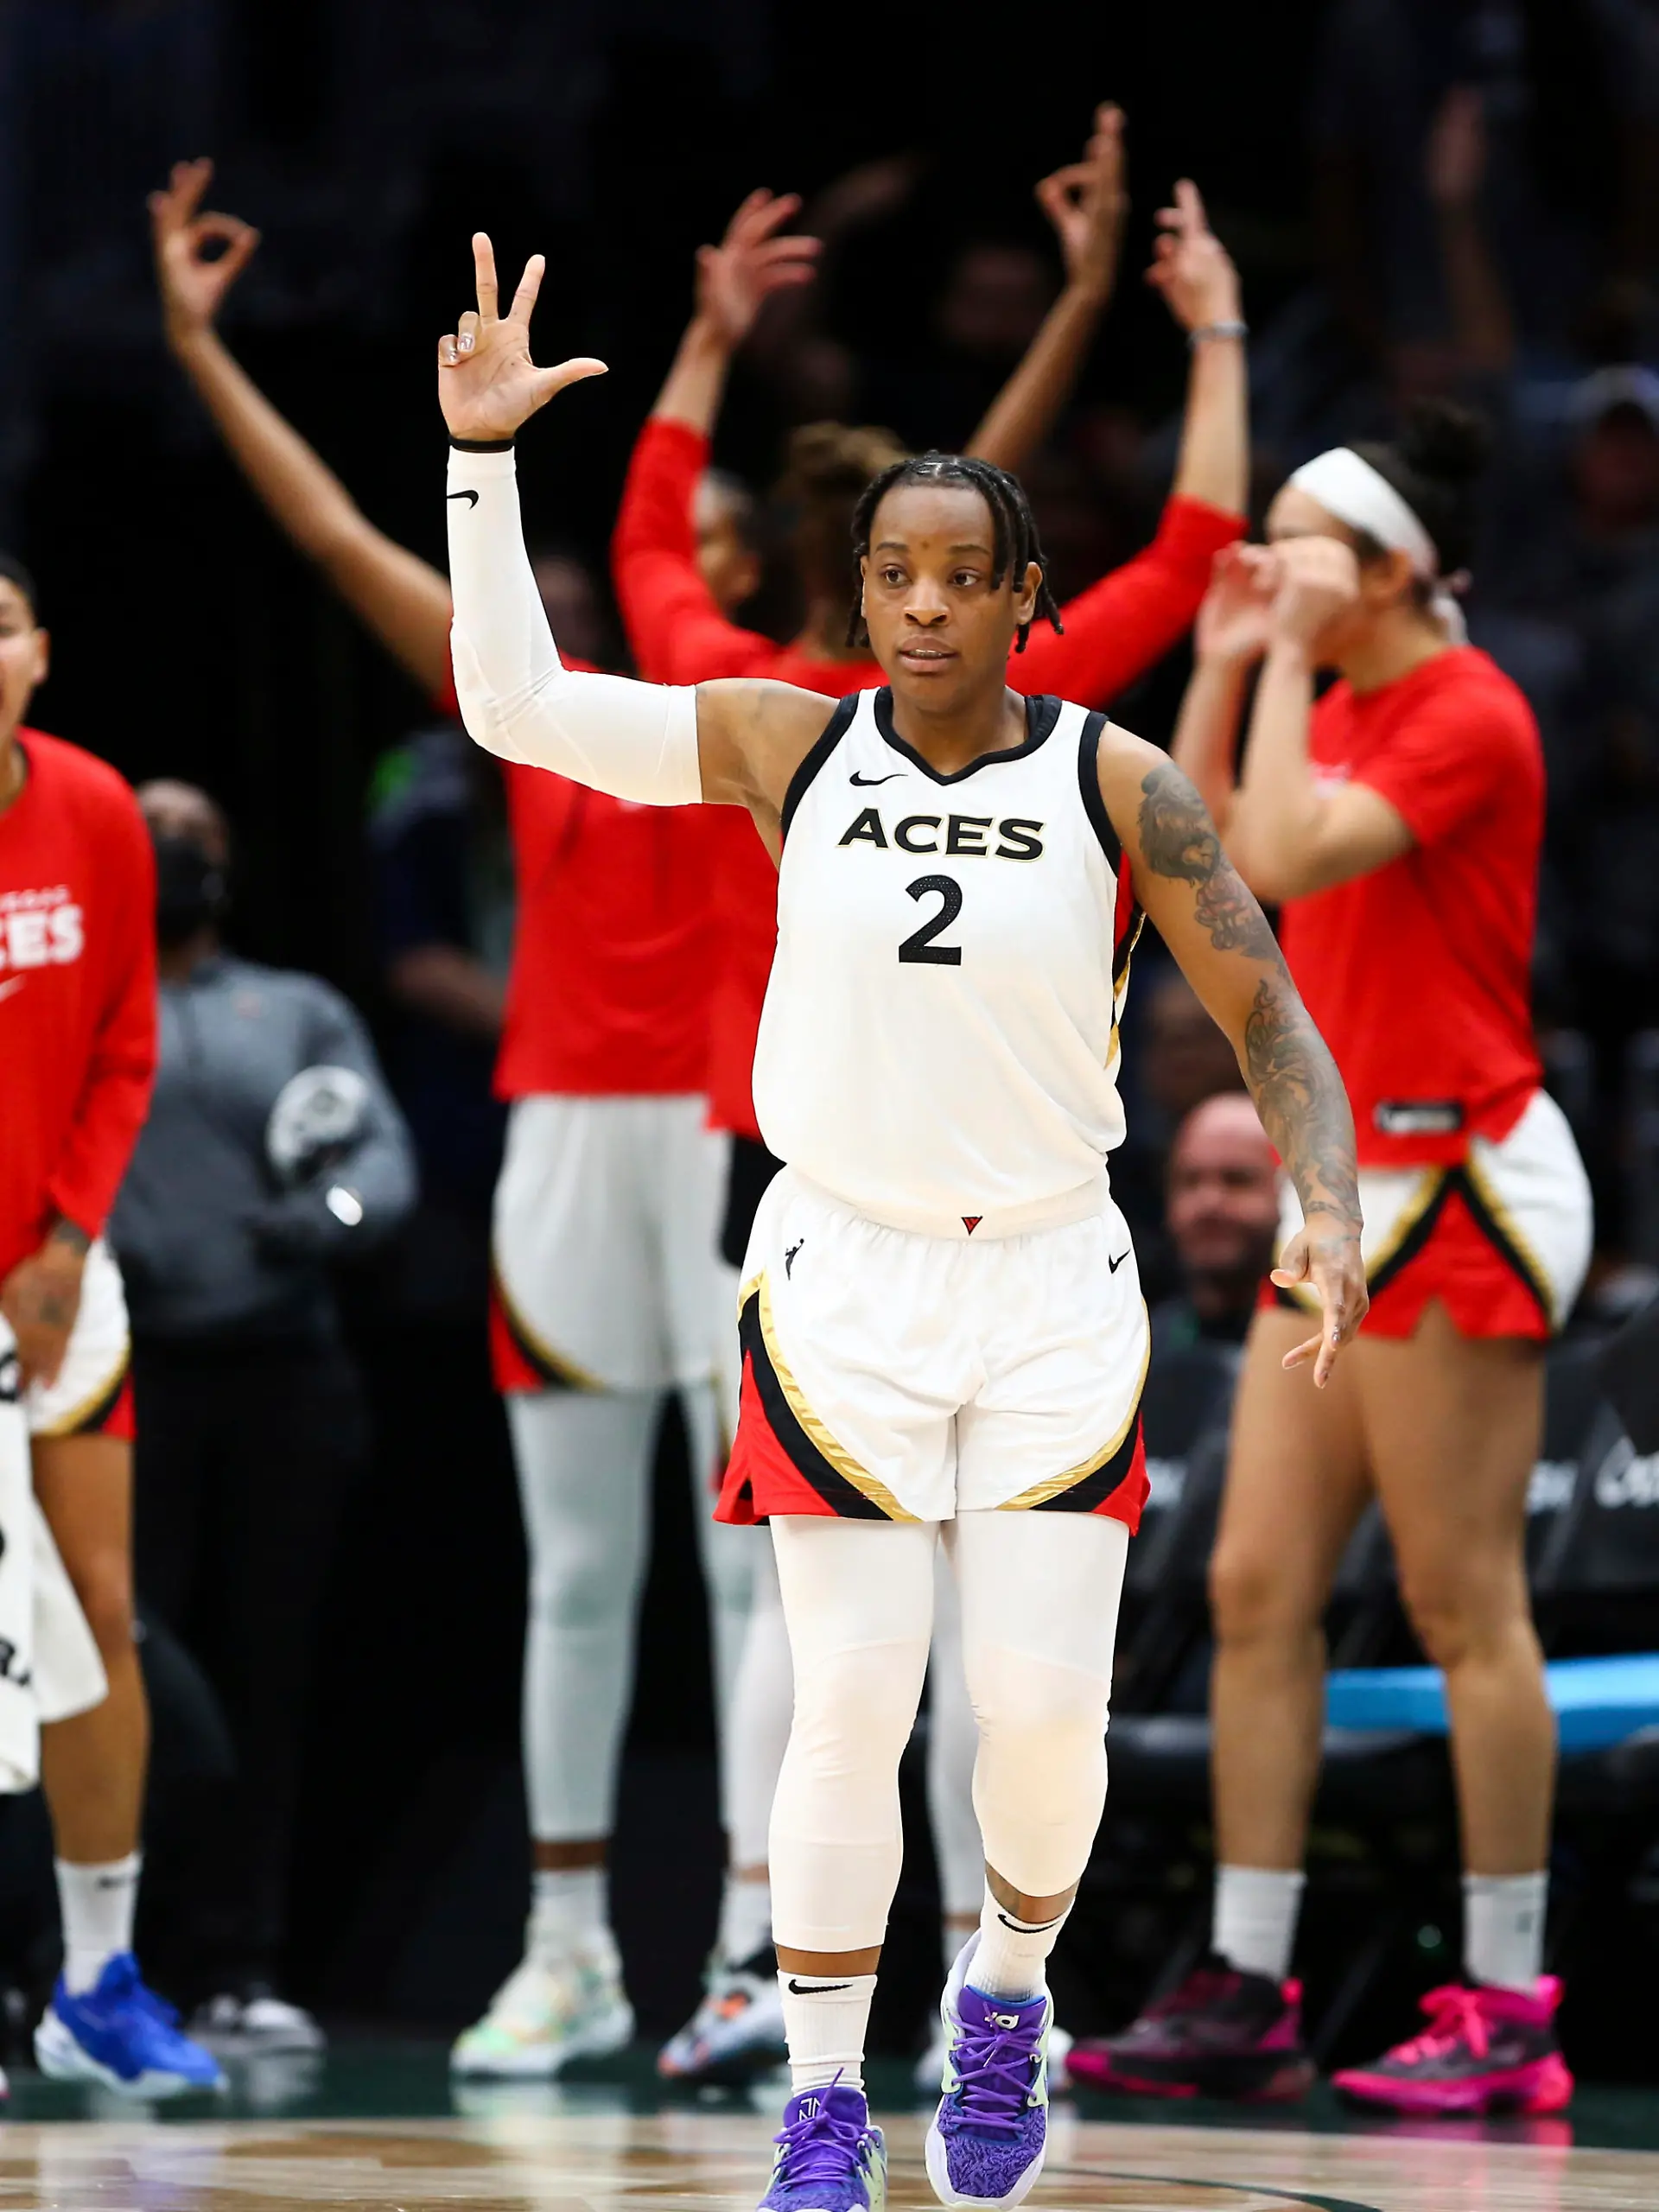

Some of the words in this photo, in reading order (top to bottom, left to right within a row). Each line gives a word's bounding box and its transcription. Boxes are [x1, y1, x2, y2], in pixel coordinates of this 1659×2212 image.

[836, 807, 1046, 862] ACES
[0, 904, 85, 969] ES
[899, 874, 963, 965] 2
